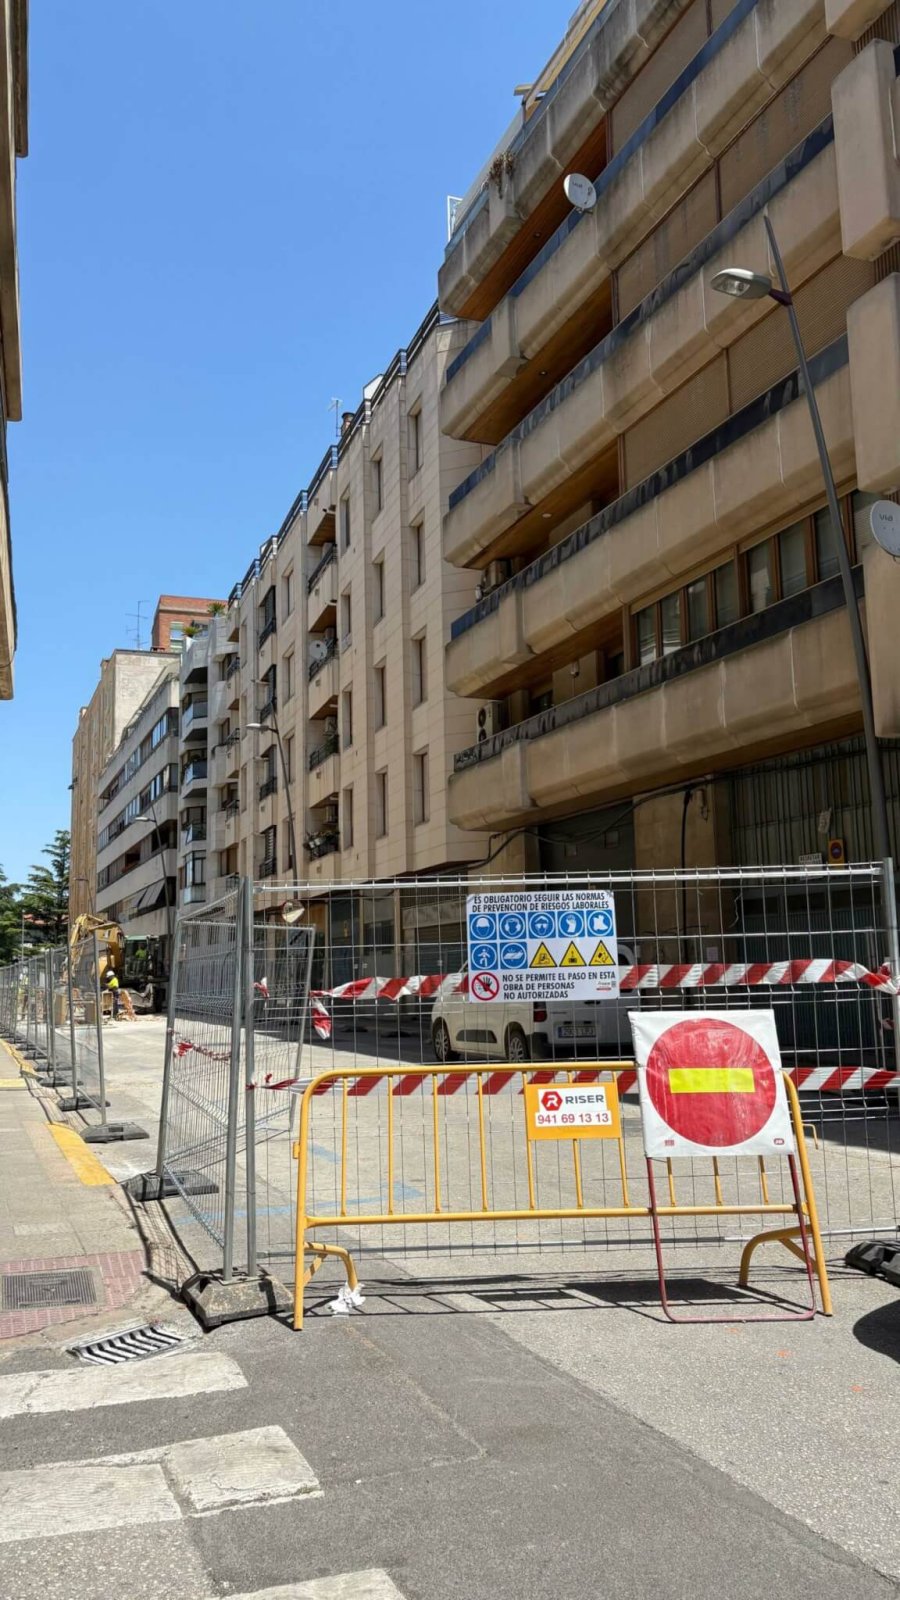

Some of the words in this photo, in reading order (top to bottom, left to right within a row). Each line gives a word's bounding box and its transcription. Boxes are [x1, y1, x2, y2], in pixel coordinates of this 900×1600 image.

[474, 896, 482, 904] ES
[484, 894, 532, 904] OBLIGATORIO
[534, 893, 560, 902] SEGUIR
[562, 893, 574, 902] LAS
[576, 892, 605, 901] NORMAS
[472, 904, 481, 912] DE
[483, 902, 528, 912] PREVENCION
[530, 902, 538, 911] DE
[540, 902, 570, 910] RIESGOS
[572, 900, 610, 910] LABORALES
[502, 974, 513, 982] NO
[516, 974, 524, 982] SE
[526, 972, 556, 982] PERMITE
[558, 972, 566, 980] EL
[568, 972, 586, 980] PASO
[588, 972, 598, 980] EN
[600, 971, 616, 980] ESTA
[504, 982, 524, 991] OBRA
[526, 982, 534, 990] DE
[536, 982, 575, 990] PERSONAS
[504, 990, 515, 1000] NO
[517, 990, 568, 999] AUTORIZADAS
[565, 1094, 604, 1104] RISER
[537, 1114, 557, 1124] 941
[561, 1114, 575, 1124] 69
[579, 1113, 592, 1122] 13
[596, 1112, 609, 1122] 13
